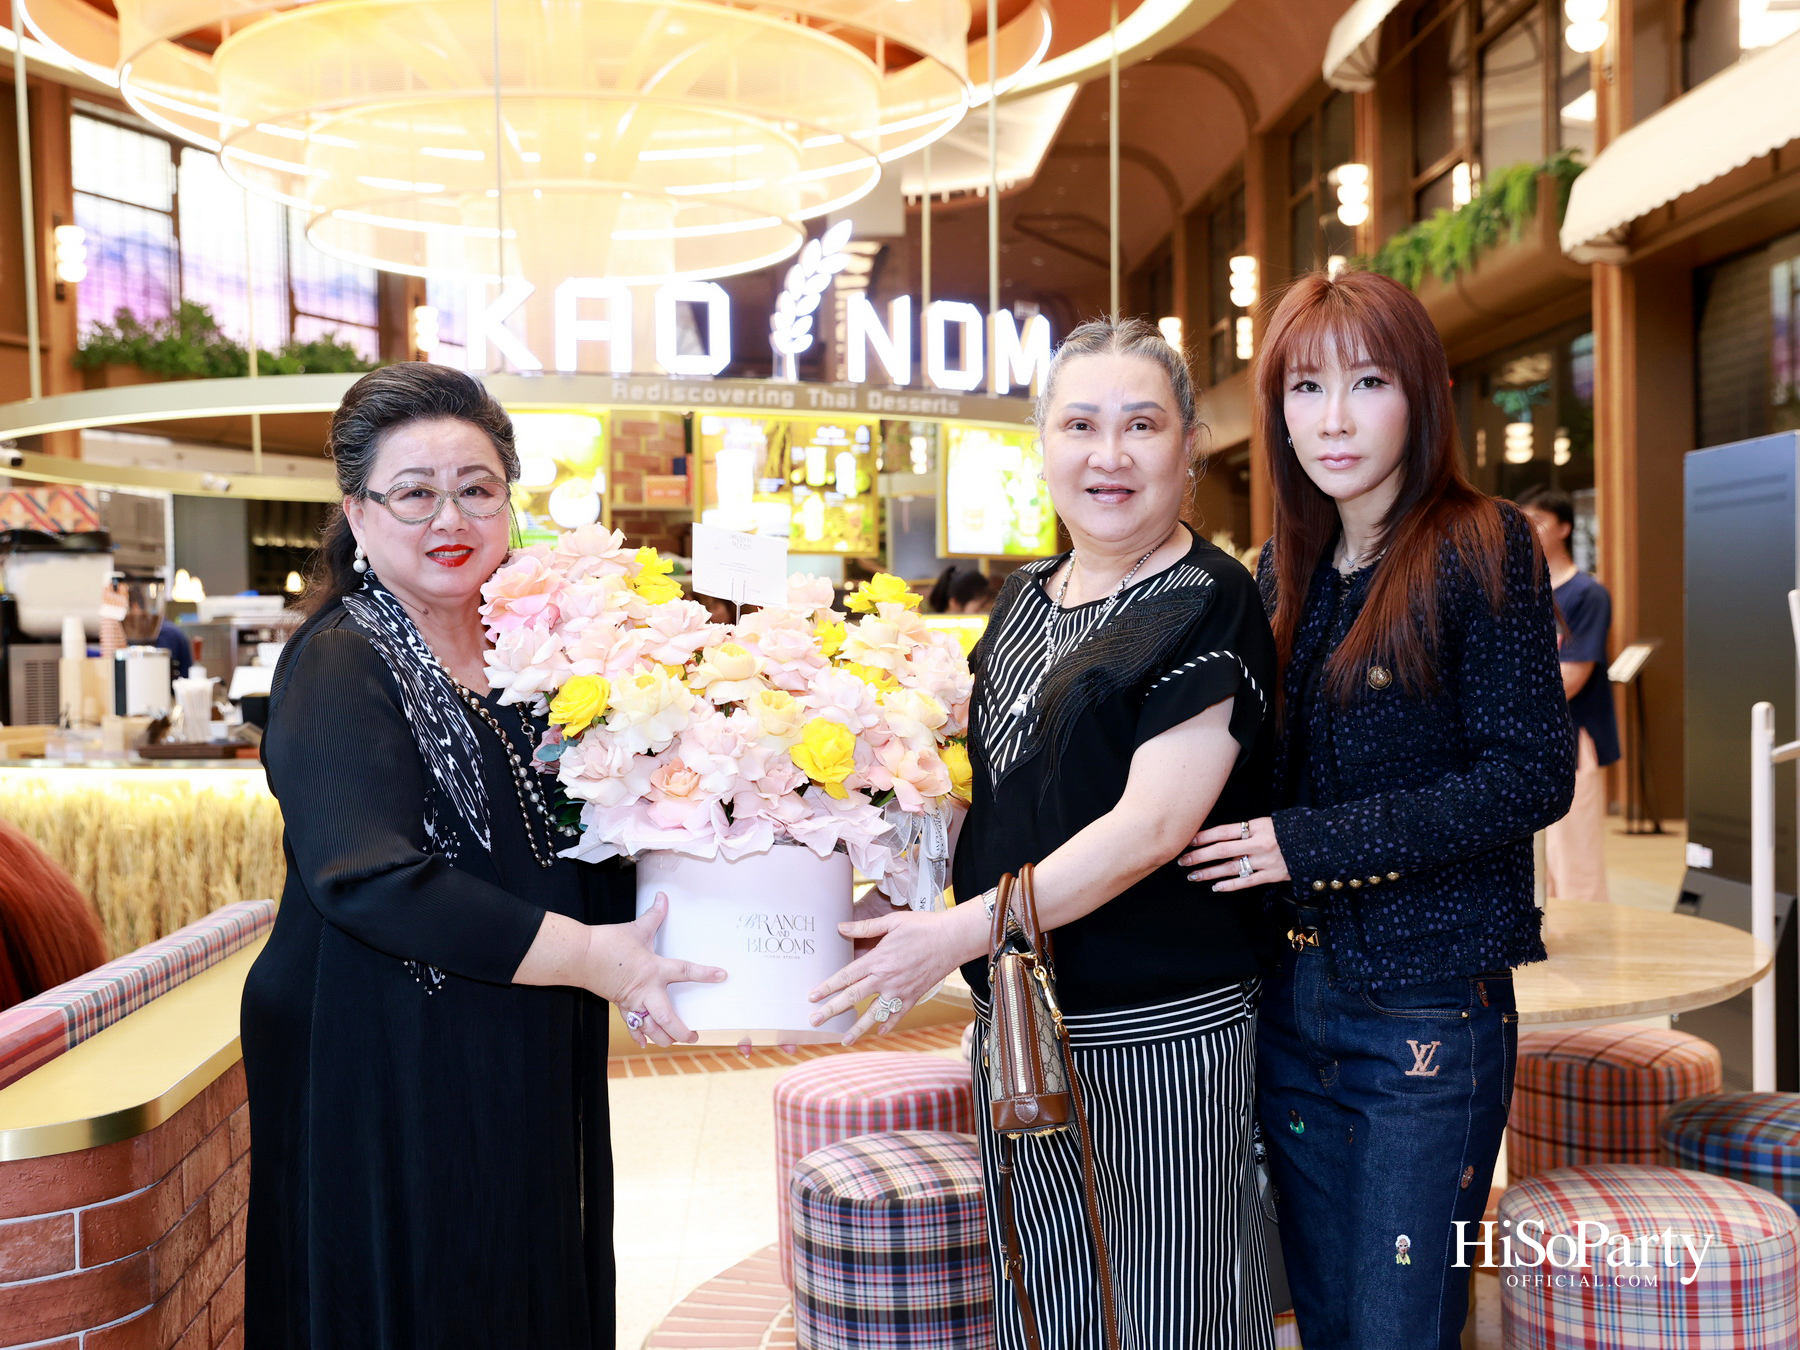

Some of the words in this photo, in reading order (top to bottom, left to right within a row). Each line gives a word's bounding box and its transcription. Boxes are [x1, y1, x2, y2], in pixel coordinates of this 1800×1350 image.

[467, 276, 731, 376] KAO
[847, 291, 1051, 397] NOM
[611, 380, 795, 408] Rediscovering
[807, 387, 857, 409] Thai
[867, 390, 960, 415] Desserts
[736, 913, 815, 935] BRANCH
[776, 930, 790, 938] AND
[747, 937, 815, 955] BLOOMS
